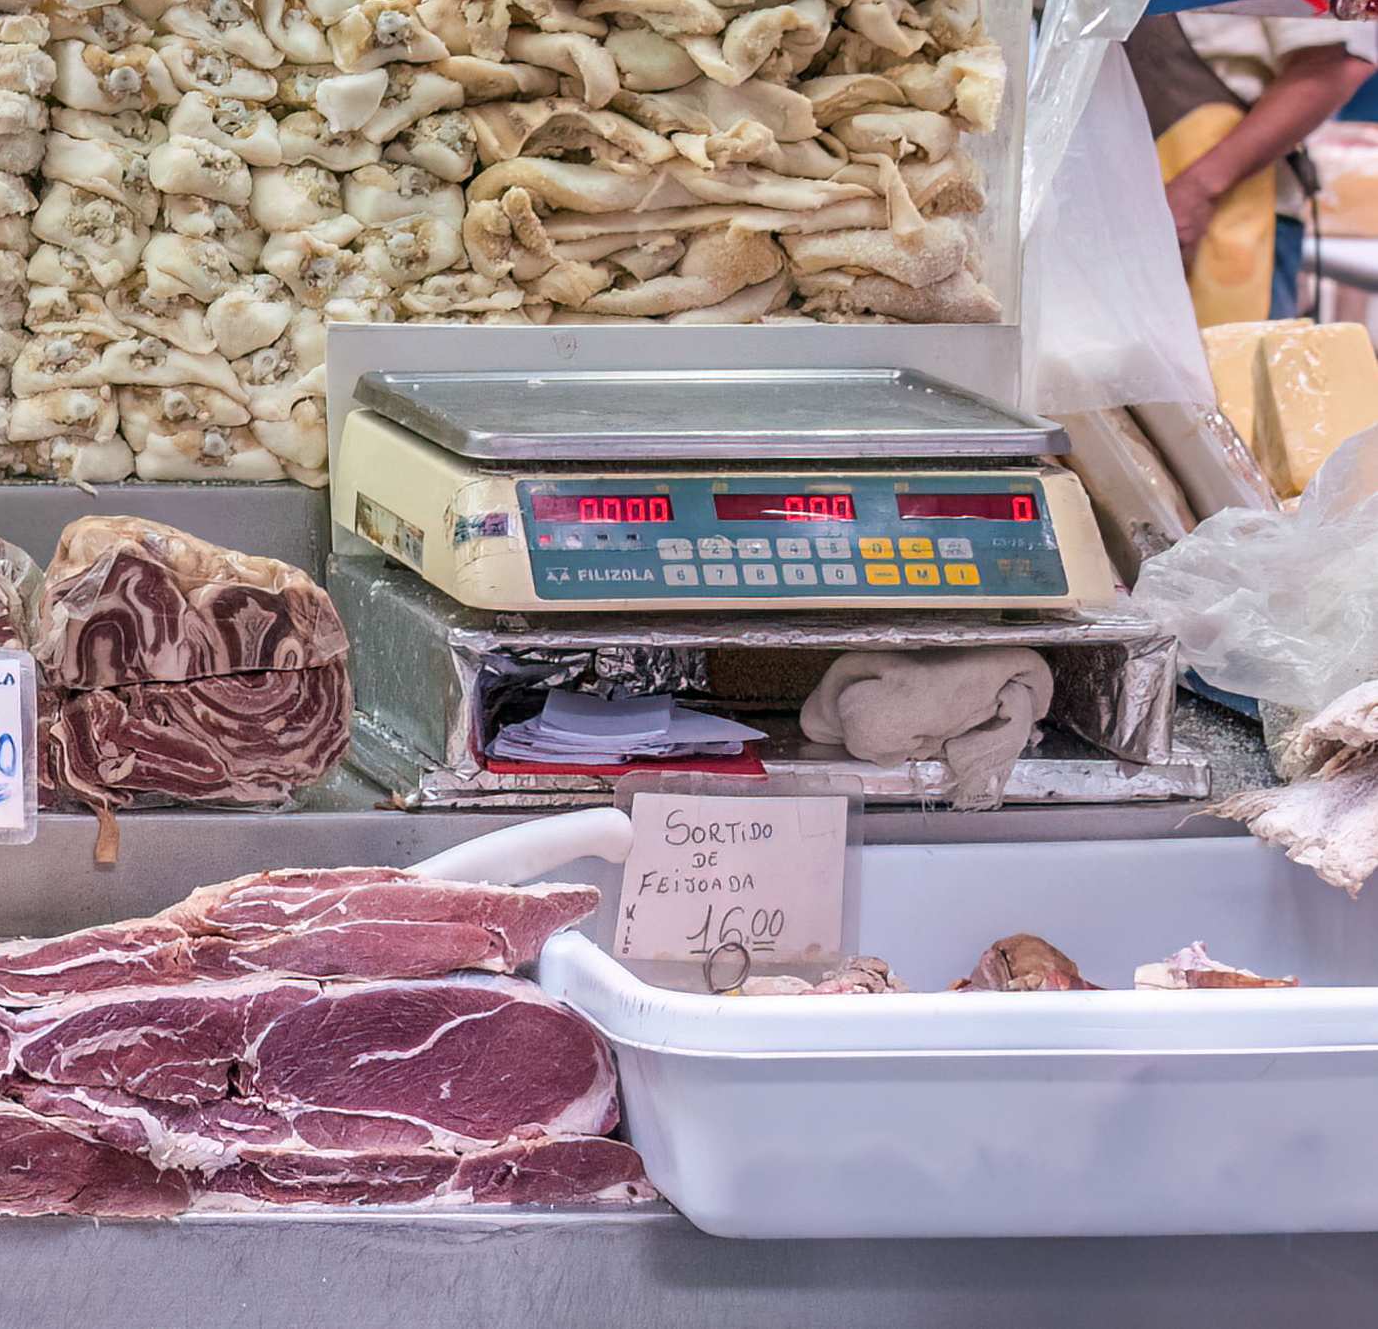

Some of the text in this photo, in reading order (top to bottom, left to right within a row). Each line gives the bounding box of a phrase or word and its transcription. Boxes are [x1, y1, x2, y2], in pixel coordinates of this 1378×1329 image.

[1012, 496, 1032, 521] 0
[577, 569, 655, 581] FILIZOLA
[677, 570, 685, 580] 6
[716, 570, 724, 580] 7
[692, 851, 718, 868] DE
[622, 904, 636, 954] KILO
